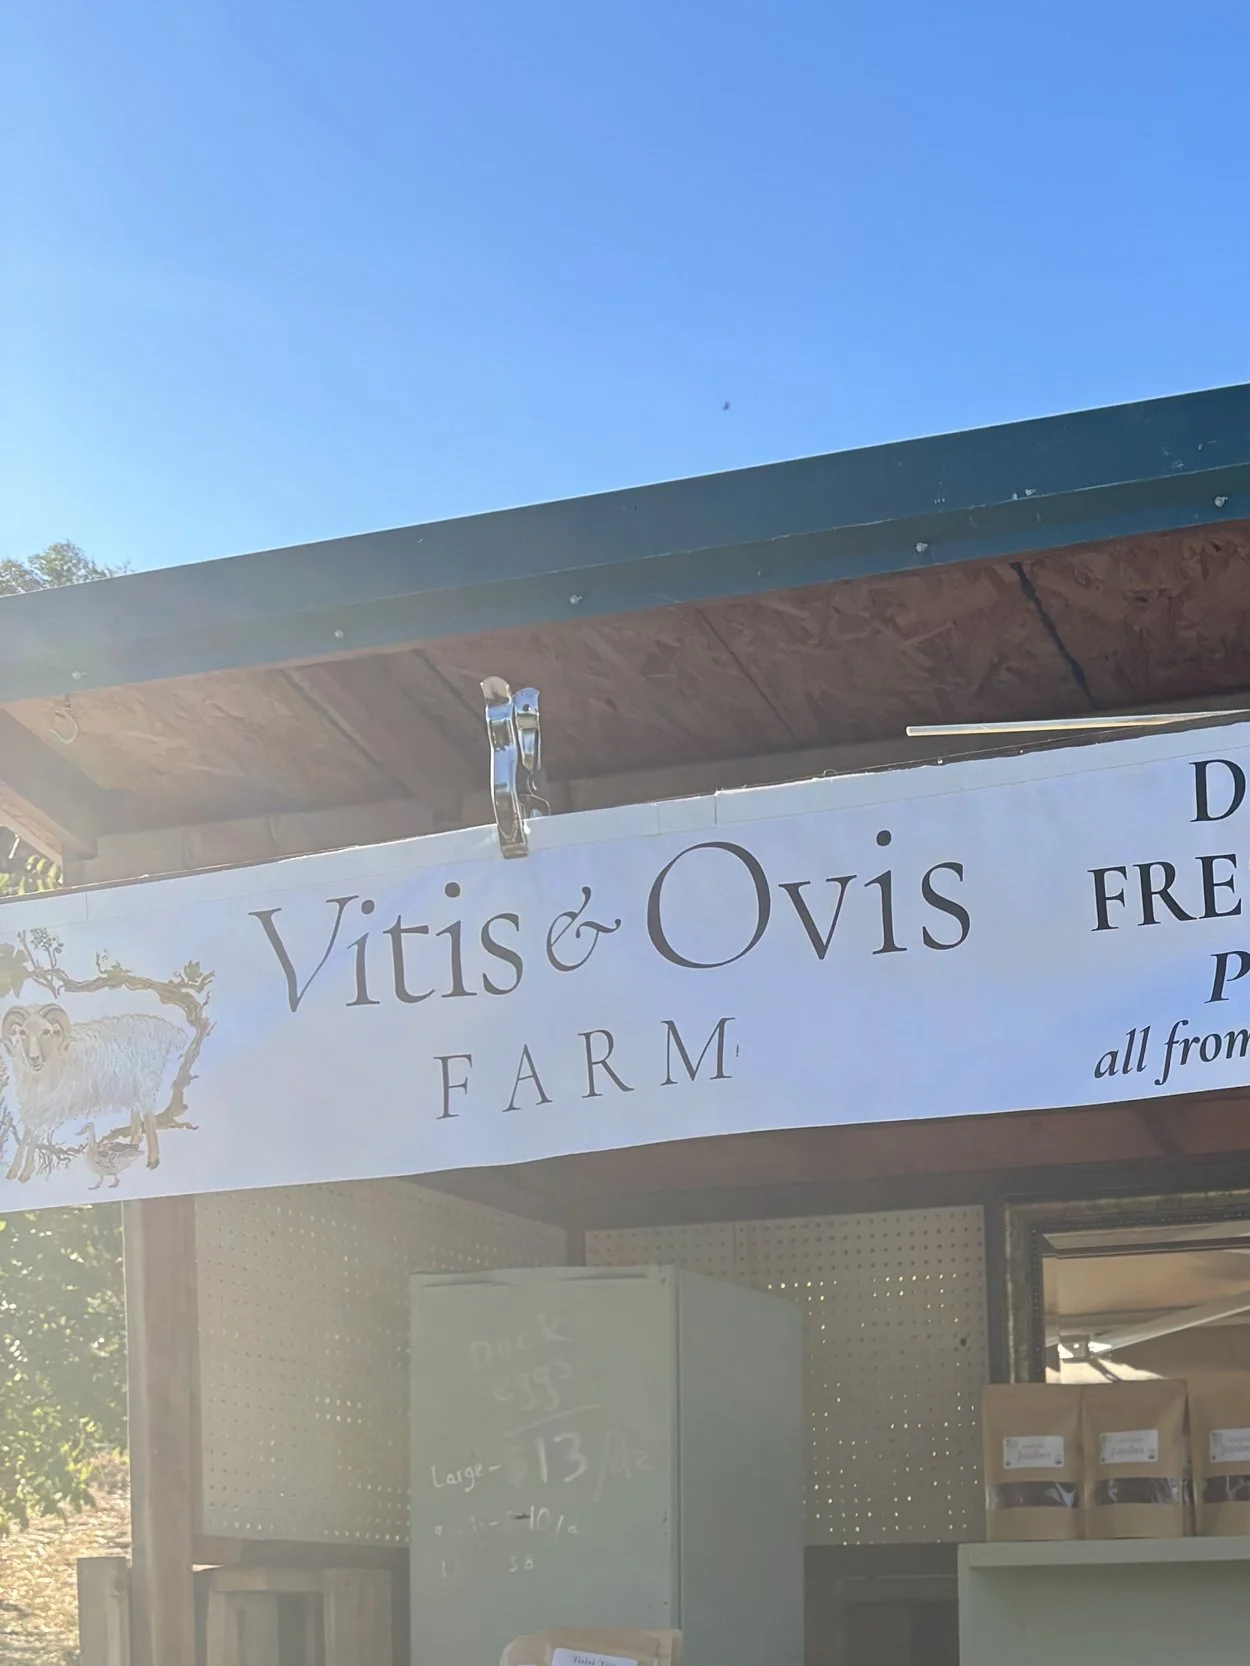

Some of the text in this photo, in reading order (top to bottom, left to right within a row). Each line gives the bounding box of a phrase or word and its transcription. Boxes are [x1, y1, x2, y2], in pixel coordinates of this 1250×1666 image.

[248, 829, 971, 1013] Vitis & Ovis
[433, 1016, 737, 1120] FARM
[1093, 1025, 1151, 1080] all
[493, 1358, 573, 1412] eggs
